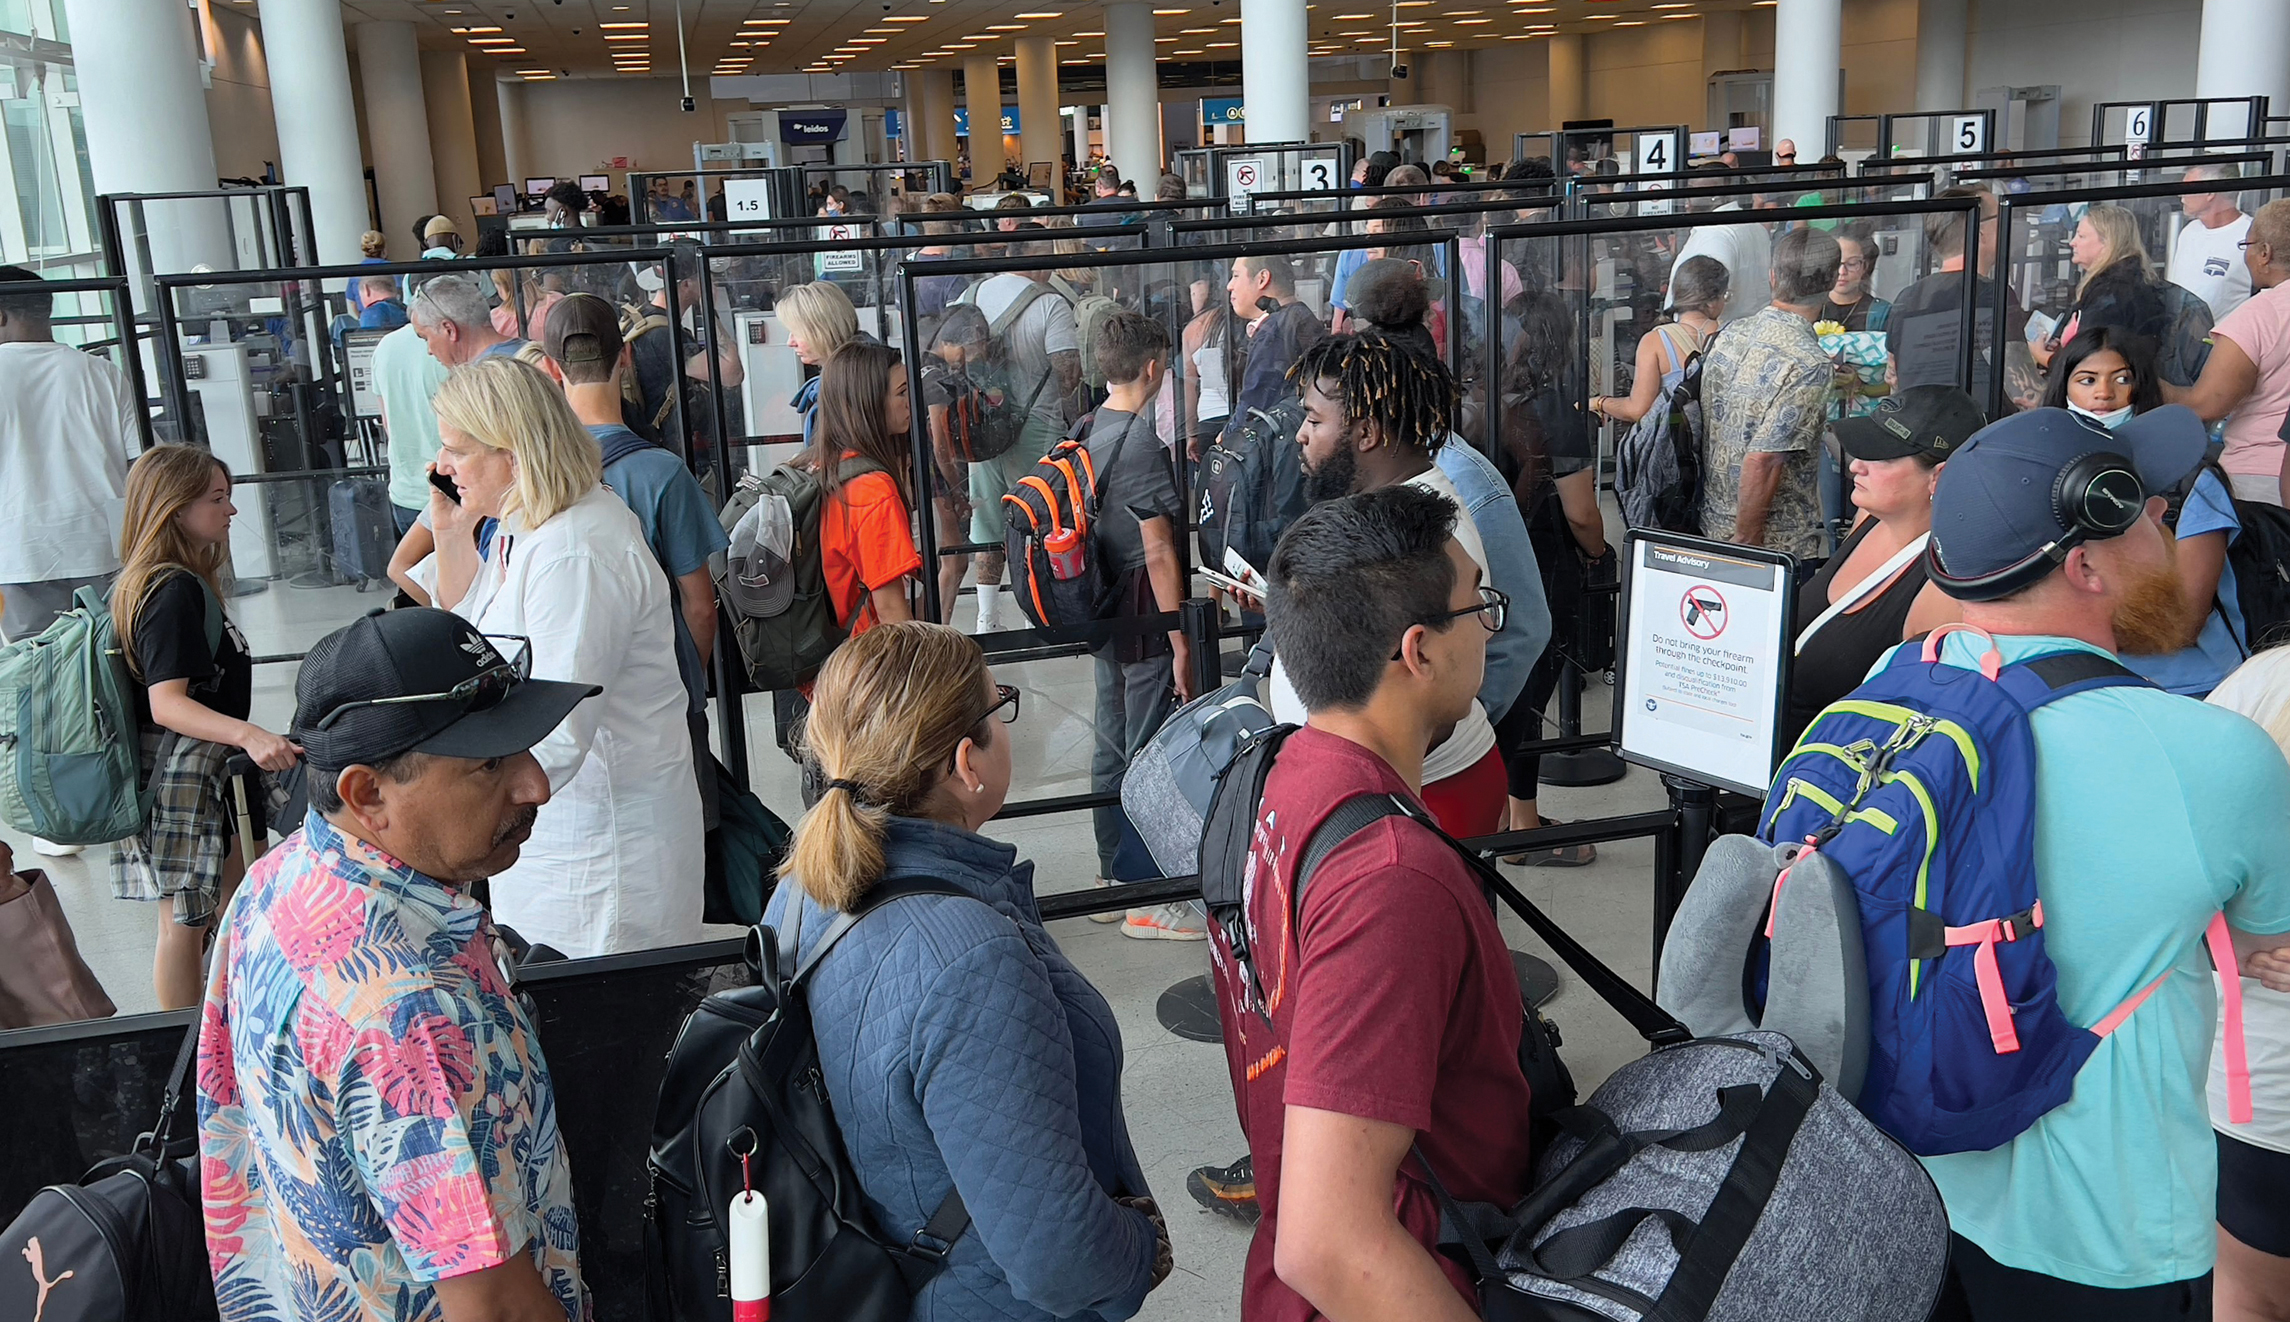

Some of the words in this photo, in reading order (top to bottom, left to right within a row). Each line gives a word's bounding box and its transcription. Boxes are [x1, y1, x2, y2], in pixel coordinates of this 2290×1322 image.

[803, 124, 829, 133] leidos
[1960, 121, 1976, 149] 5
[2132, 110, 2146, 136] 6
[1646, 139, 1667, 170] 4
[1310, 164, 1329, 191] 3
[736, 200, 759, 212] 1.5
[1653, 550, 1676, 562] Travel
[1676, 555, 1710, 570] Advisory
[1652, 633, 1664, 644] Do
[1664, 638, 1678, 647] not
[1679, 640, 1701, 654] bring
[1702, 646, 1721, 656] your
[1723, 649, 1754, 664] firearm
[1655, 645, 1687, 660] through
[1688, 653, 1701, 664] the
[1702, 657, 1749, 675] checkpoint.
[1664, 670, 1676, 679] and
[1720, 684, 1737, 693] from
[1678, 681, 1690, 690] TSA
